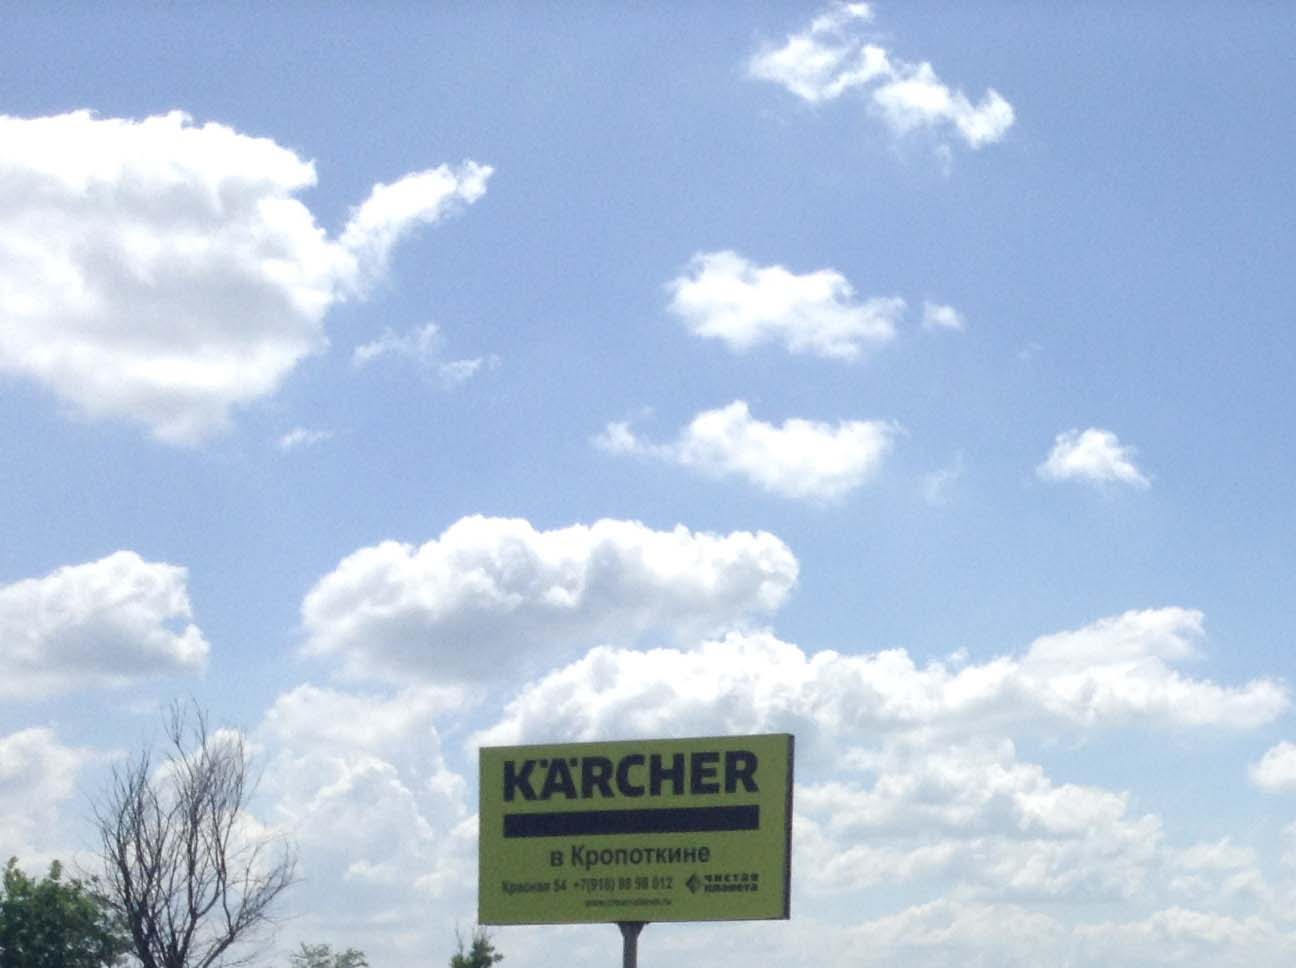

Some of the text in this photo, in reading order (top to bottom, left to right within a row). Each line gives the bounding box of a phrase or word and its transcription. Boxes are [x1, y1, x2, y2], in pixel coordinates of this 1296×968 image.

[503, 751, 759, 802] KÄRCHER
[550, 845, 711, 871] в Кропоткине
